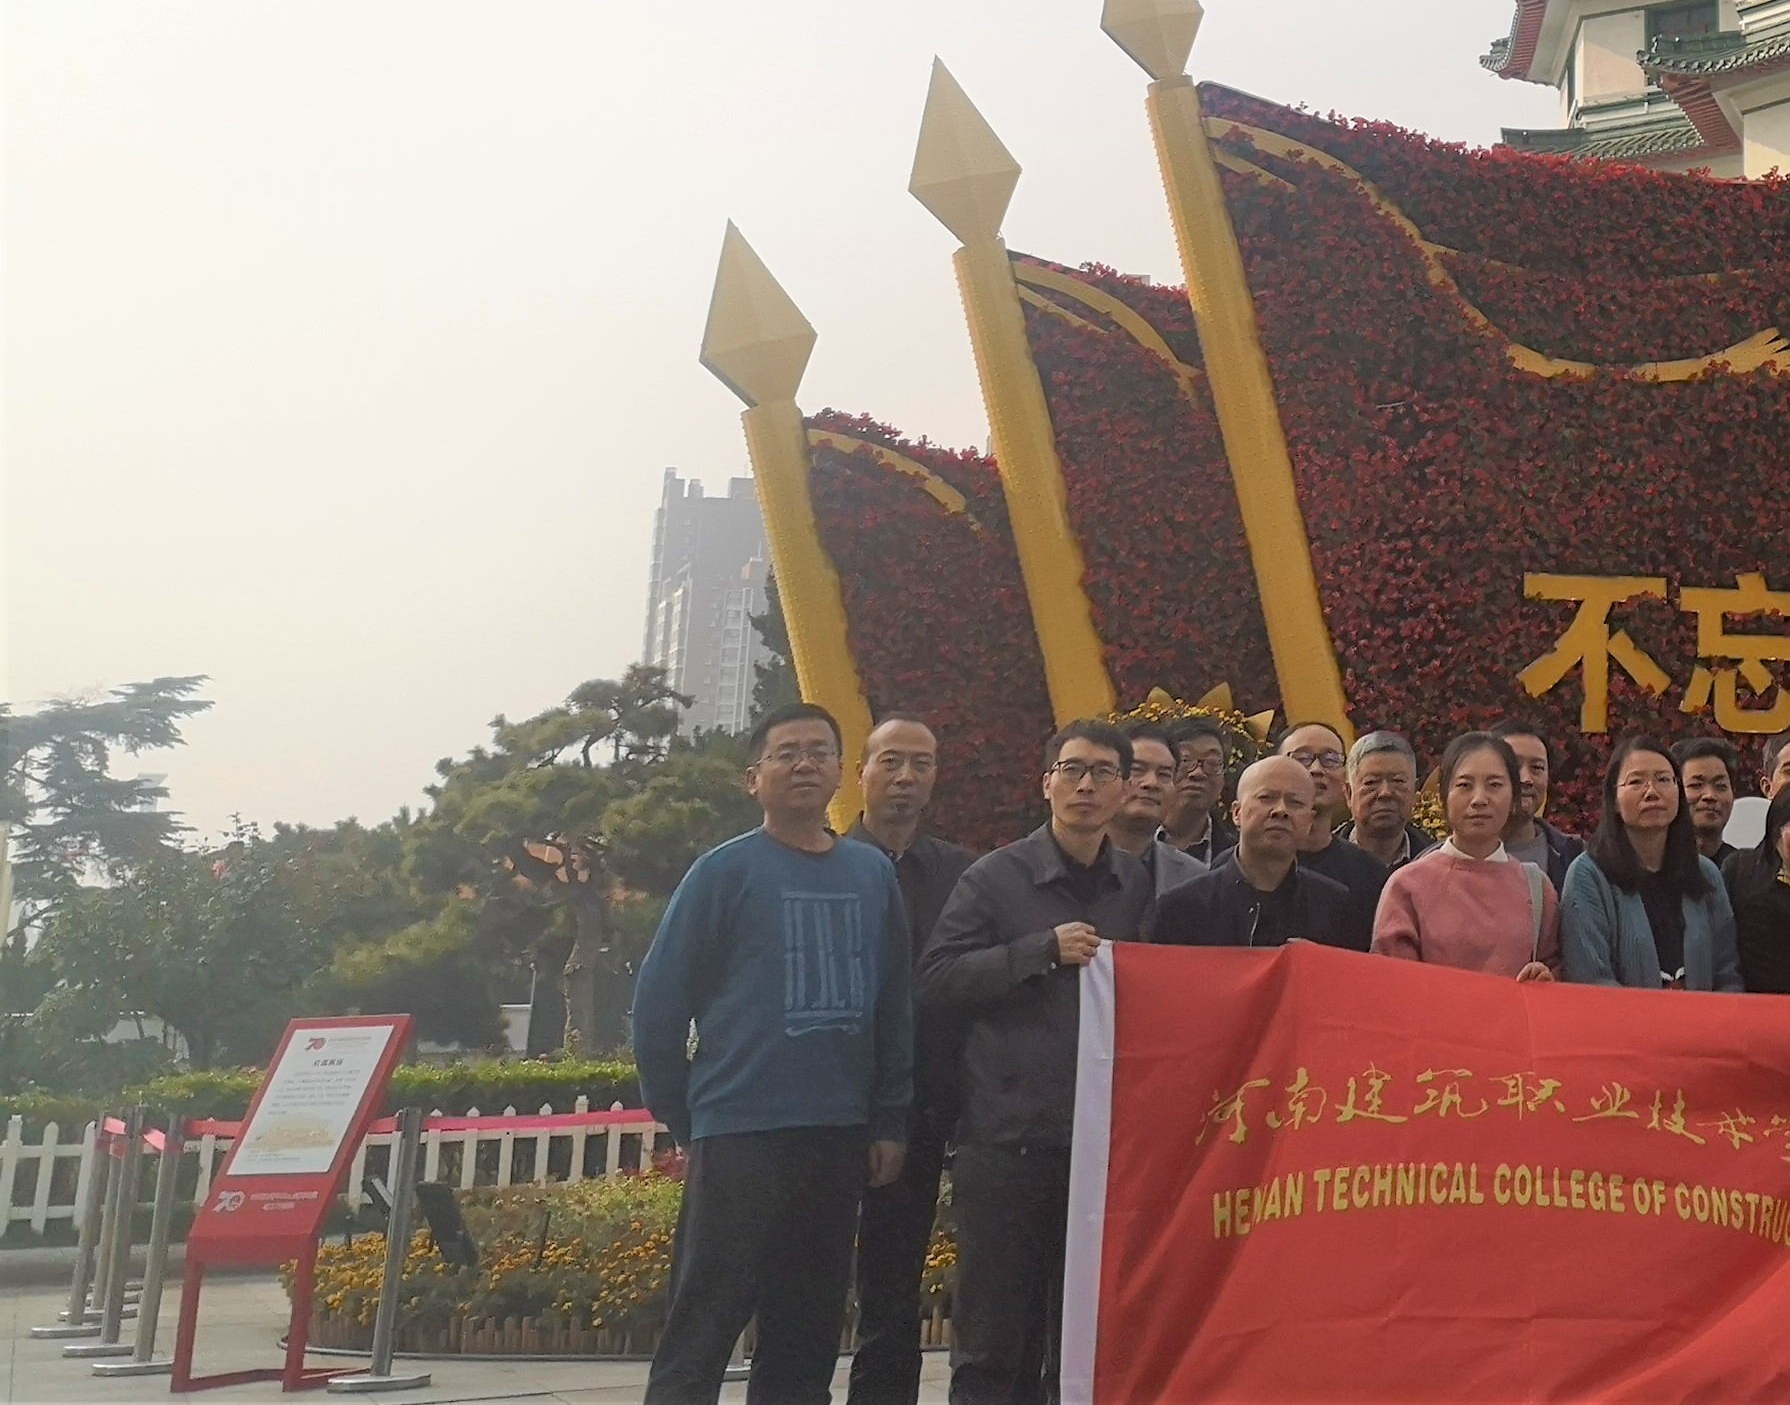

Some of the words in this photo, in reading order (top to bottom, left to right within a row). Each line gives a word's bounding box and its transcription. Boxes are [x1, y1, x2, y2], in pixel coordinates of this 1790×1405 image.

[1213, 1171, 1304, 1239] HENAN
[1314, 1162, 1485, 1212] TECHNICAL
[1493, 1163, 1626, 1213] COLLEGE
[1632, 1176, 1668, 1216] OF
